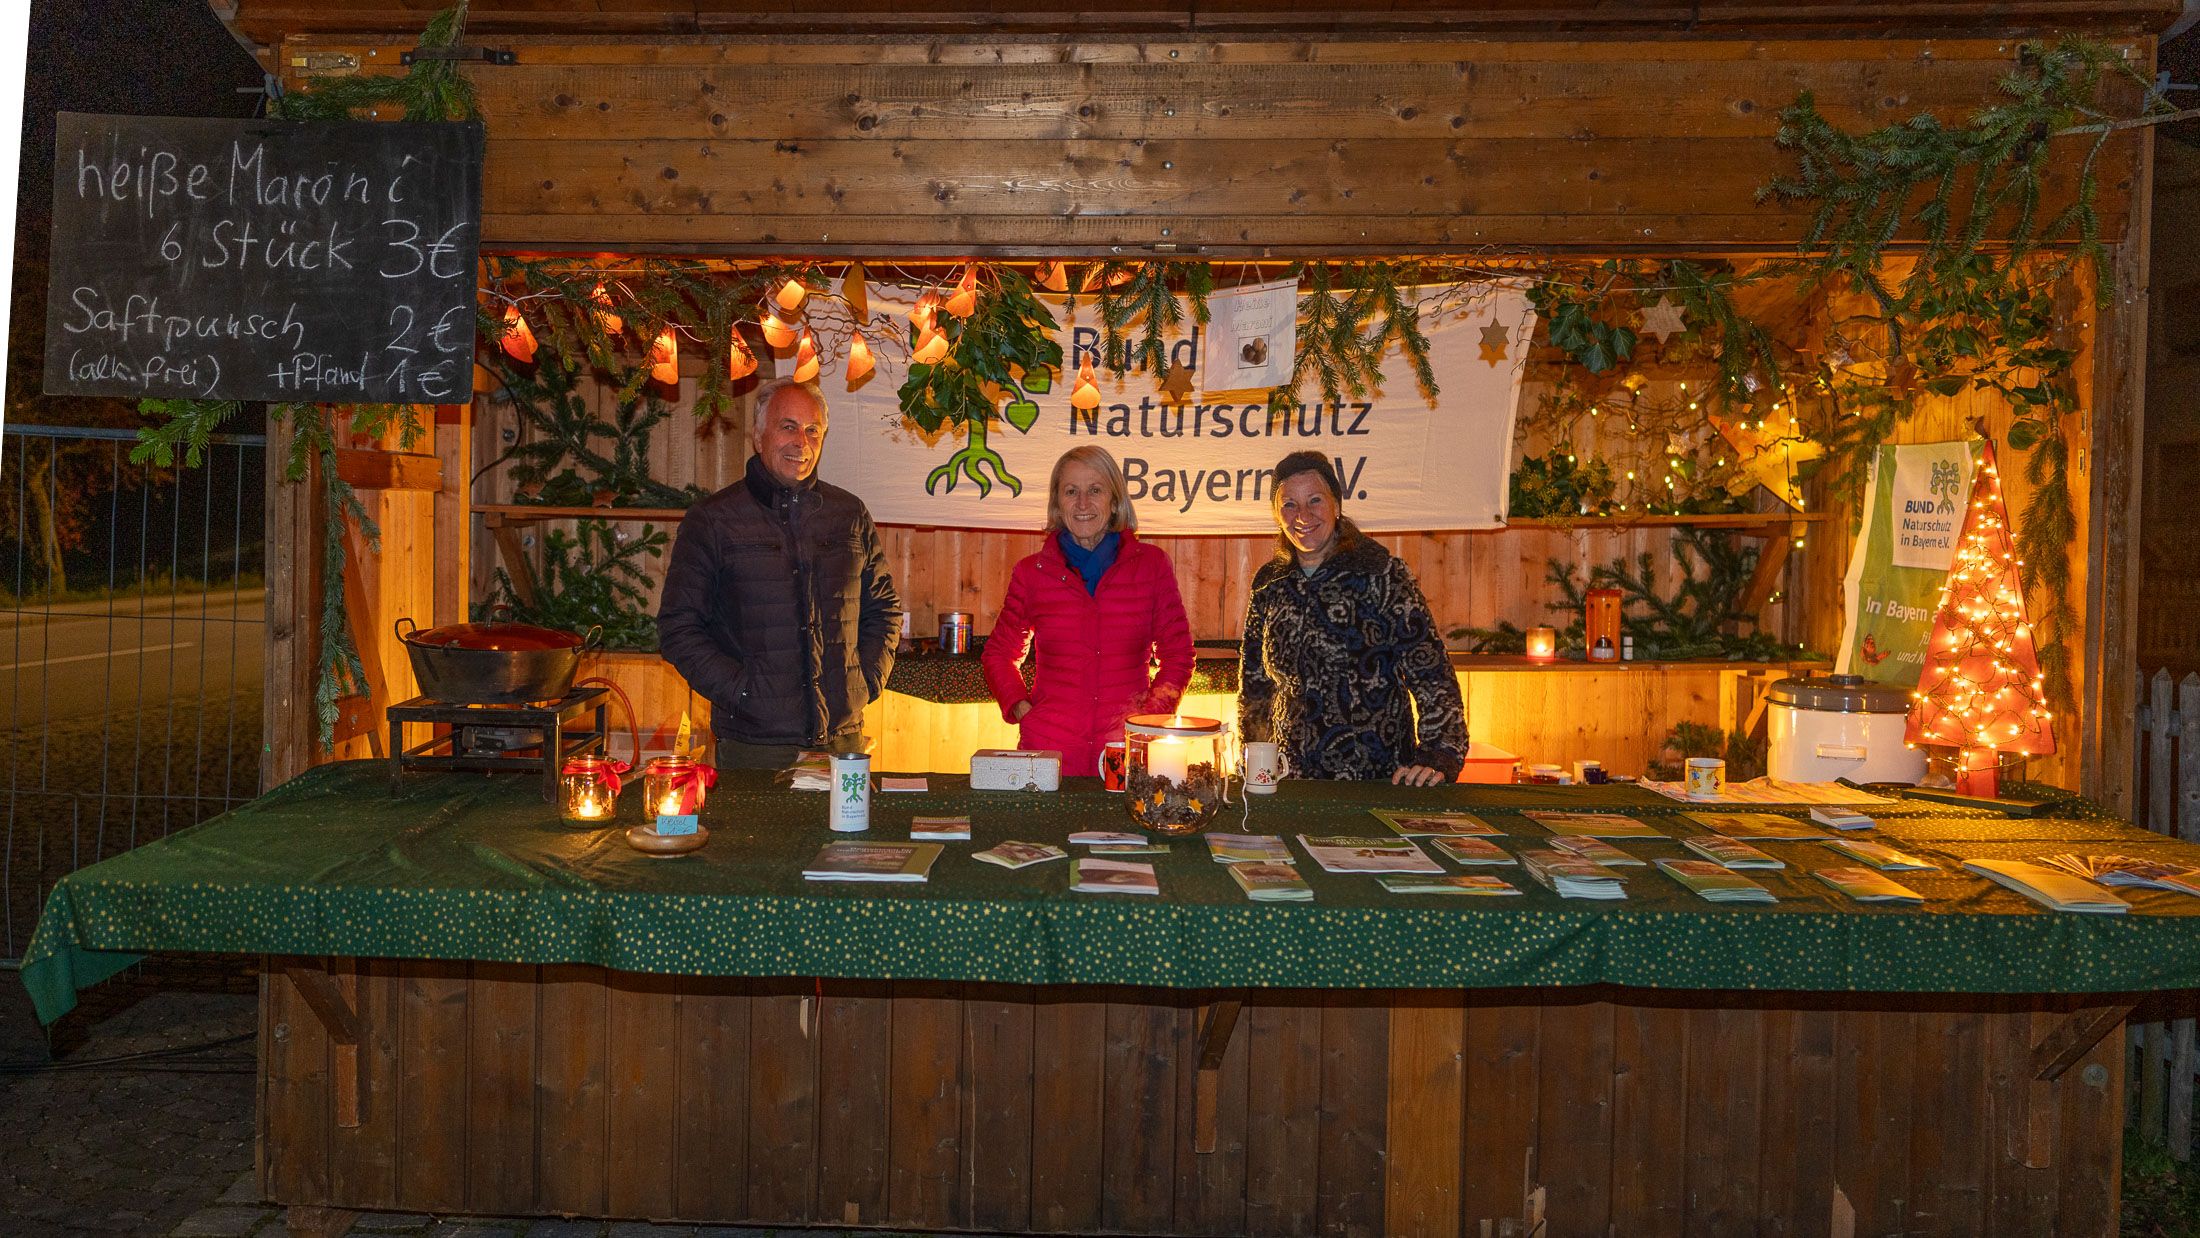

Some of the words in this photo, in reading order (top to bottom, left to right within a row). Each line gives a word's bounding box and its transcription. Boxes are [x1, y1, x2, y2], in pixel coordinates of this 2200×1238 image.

[78, 147, 208, 219] heiße
[160, 221, 183, 263] 6
[202, 219, 356, 271] Stück
[63, 287, 305, 352] Saftpunsch
[1069, 391, 1373, 438] Naturschutz
[1122, 457, 1277, 514] Bayern
[1902, 518, 1952, 532] Naturschutz
[1904, 500, 1935, 514] BUND
[1900, 533, 1911, 546] in
[1912, 534, 1937, 550] Bayern
[1865, 596, 1882, 615] In
[1886, 600, 1928, 624] Bayern
[1896, 650, 1918, 664] und
